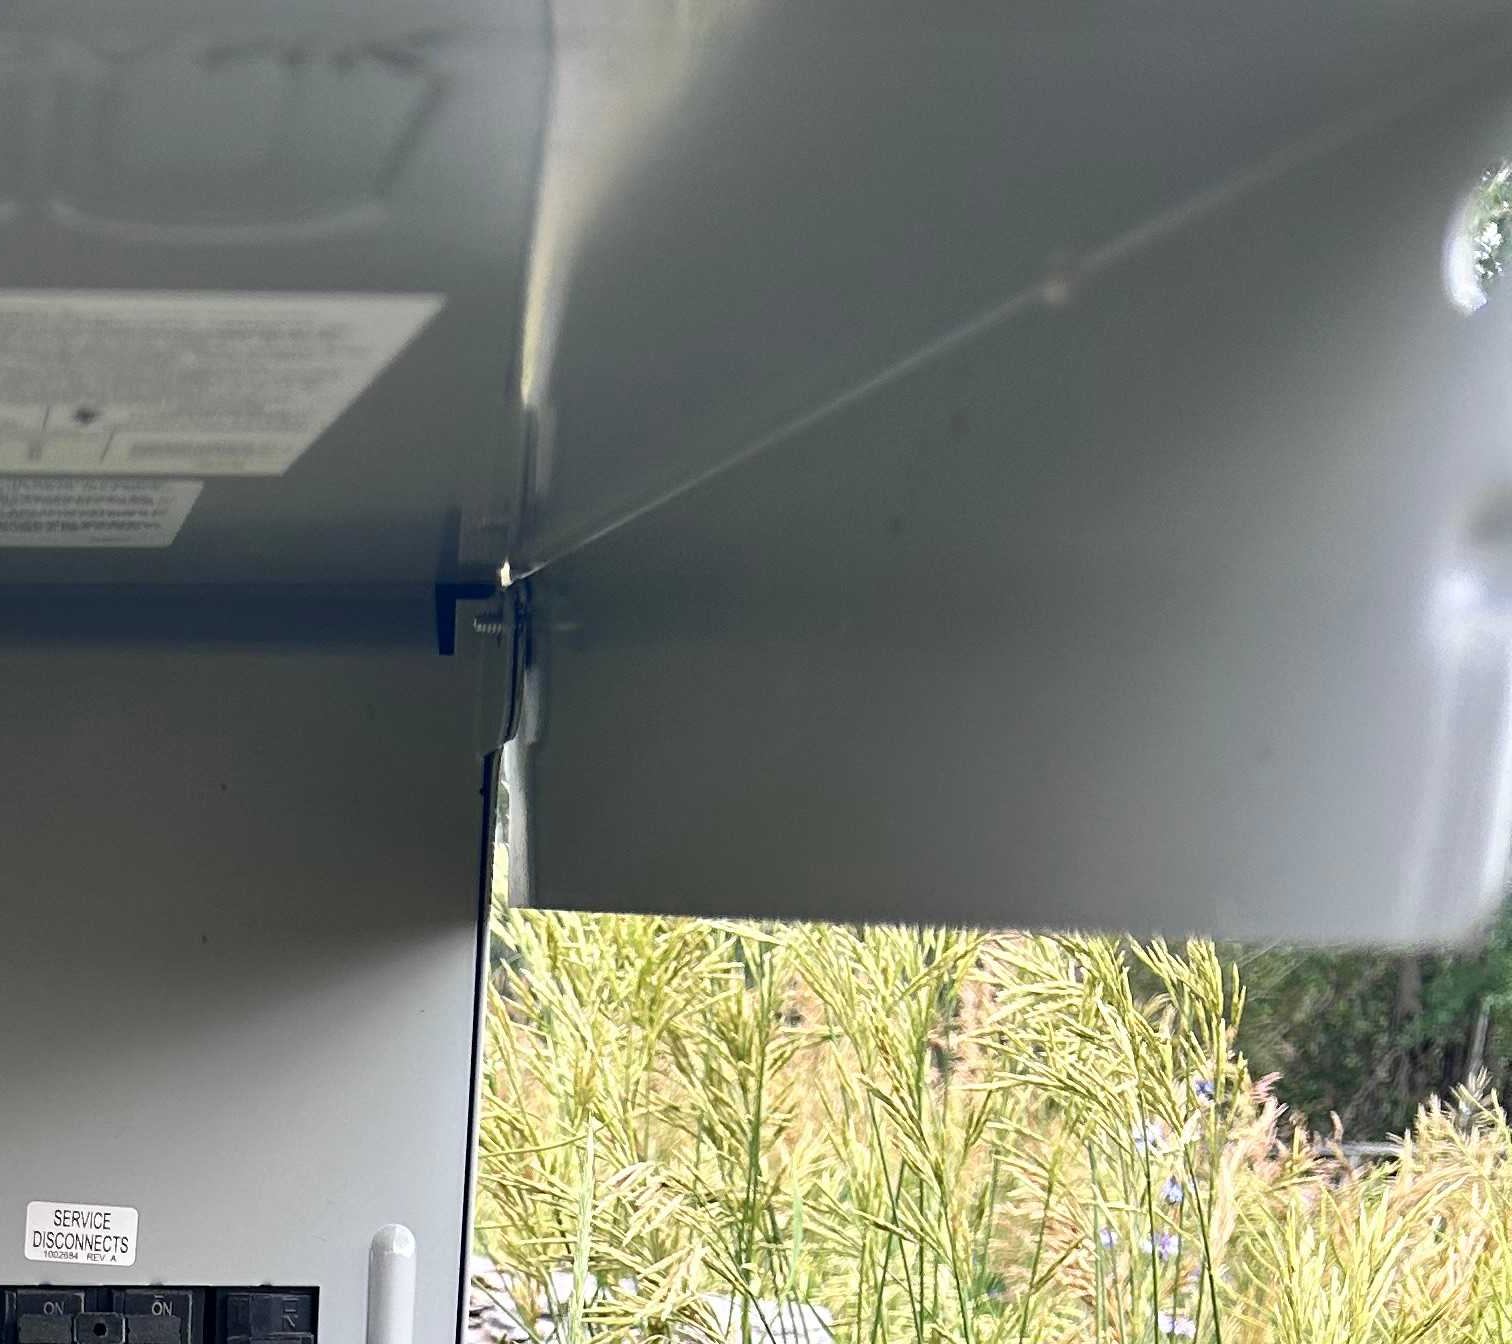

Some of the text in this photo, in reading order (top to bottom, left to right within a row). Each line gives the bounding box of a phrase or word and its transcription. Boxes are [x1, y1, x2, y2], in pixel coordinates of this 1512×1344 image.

[53, 1209, 112, 1230] SERVICE
[32, 1230, 129, 1254] DISCONNECTS
[86, 1252, 106, 1262] REV
[110, 1254, 118, 1262] A
[43, 1301, 65, 1315] ON
[151, 1301, 173, 1316] ON
